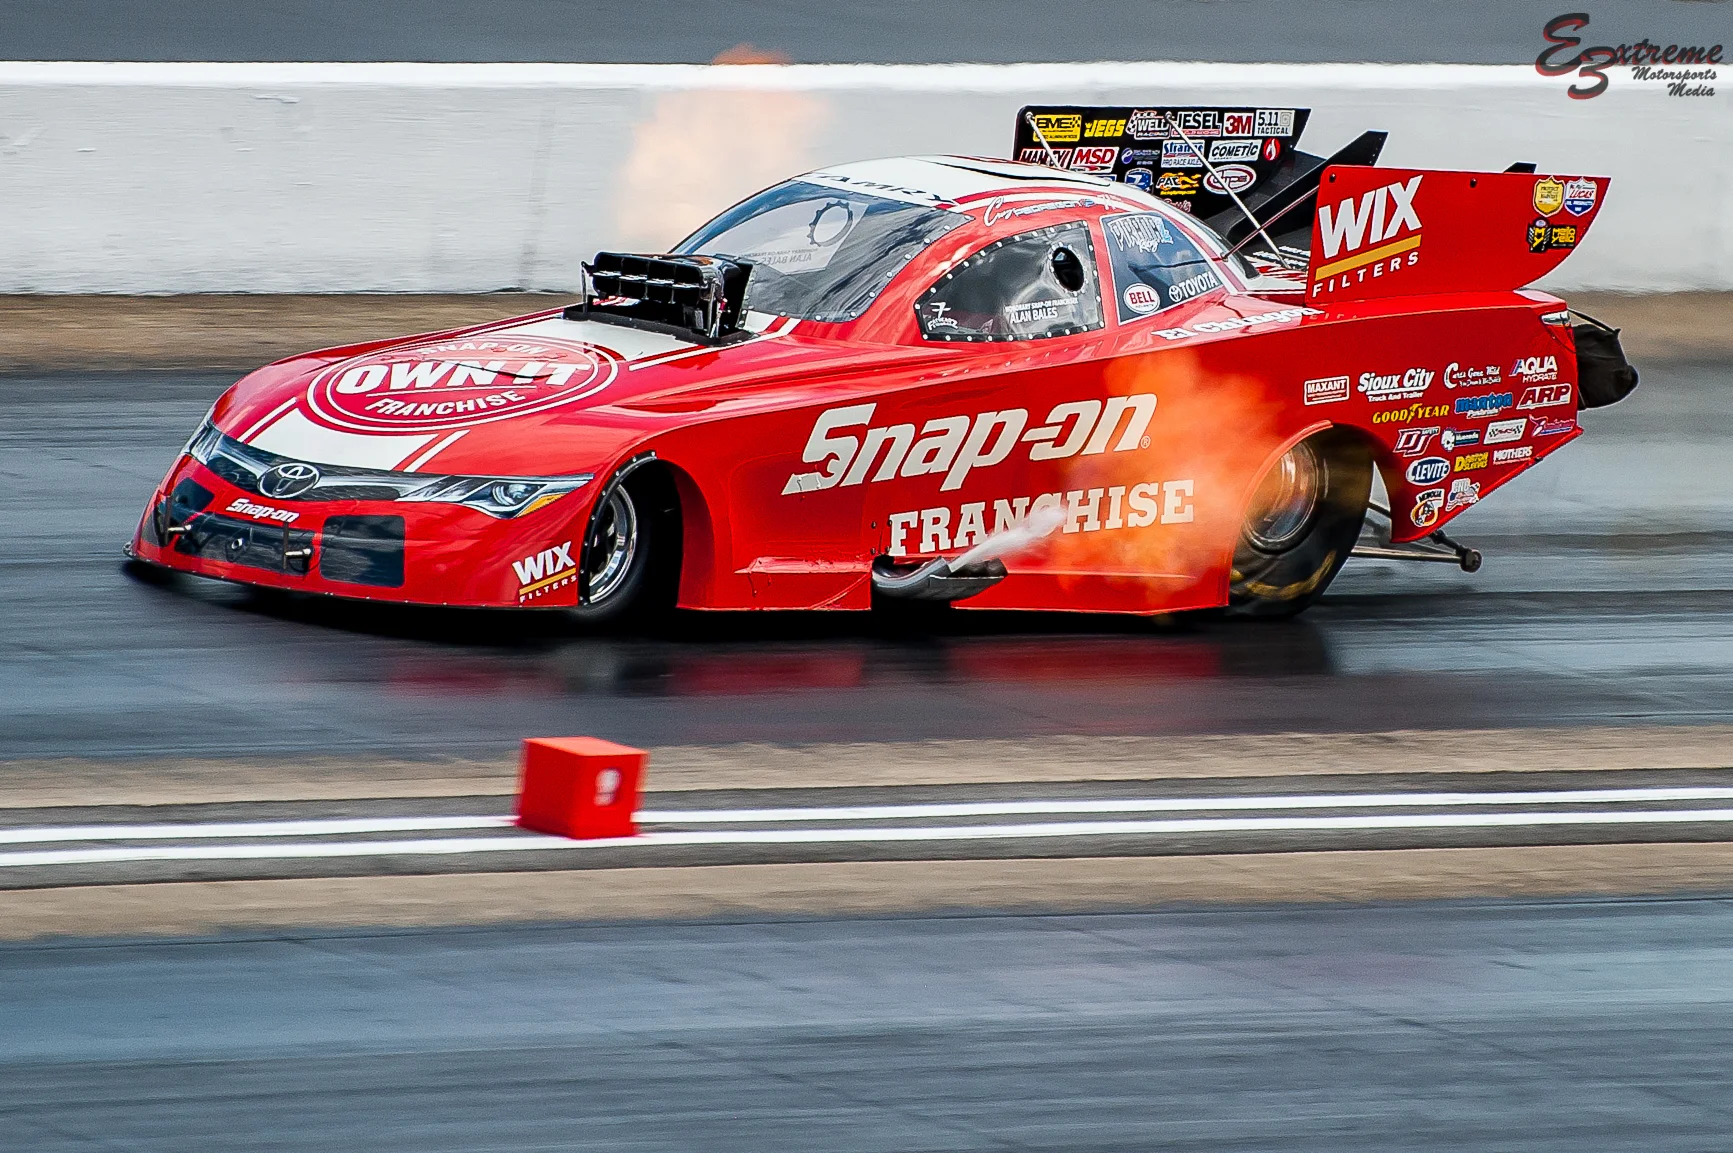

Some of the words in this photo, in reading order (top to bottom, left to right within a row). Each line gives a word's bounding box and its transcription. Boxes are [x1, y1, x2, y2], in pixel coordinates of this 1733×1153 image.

[1137, 119, 1169, 131] WELD
[1225, 115, 1252, 134] 3M
[1257, 111, 1279, 126] 5.11
[1084, 120, 1126, 137] JEGS
[1257, 127, 1289, 135] TACTICAL
[1073, 149, 1115, 165] MSD
[1212, 142, 1259, 157] COMETIC
[1318, 175, 1423, 259] WIX
[1312, 251, 1419, 297] FILTERS
[1181, 272, 1218, 297] TOYOTA
[1129, 292, 1155, 304] BELL
[1010, 309, 1032, 324] ALAN
[1032, 307, 1058, 322] BALES
[1516, 356, 1558, 376] AQUA
[335, 361, 506, 394] OWN
[512, 361, 593, 387] IT
[1307, 380, 1347, 393] MAXANT
[1357, 372, 1401, 392] Sioux
[1402, 368, 1435, 389] City
[1522, 372, 1557, 383] HYDRATE
[364, 389, 527, 417] FRANCHISE
[1403, 391, 1424, 399] Trailer
[1519, 385, 1570, 404] ARP
[781, 393, 1158, 495] Snap-on
[1493, 447, 1533, 461] MOTHERS
[1406, 458, 1450, 483] CLEVITE
[226, 498, 300, 523] Snap-on
[512, 541, 576, 585] WIX
[519, 575, 577, 603] FILTERS
